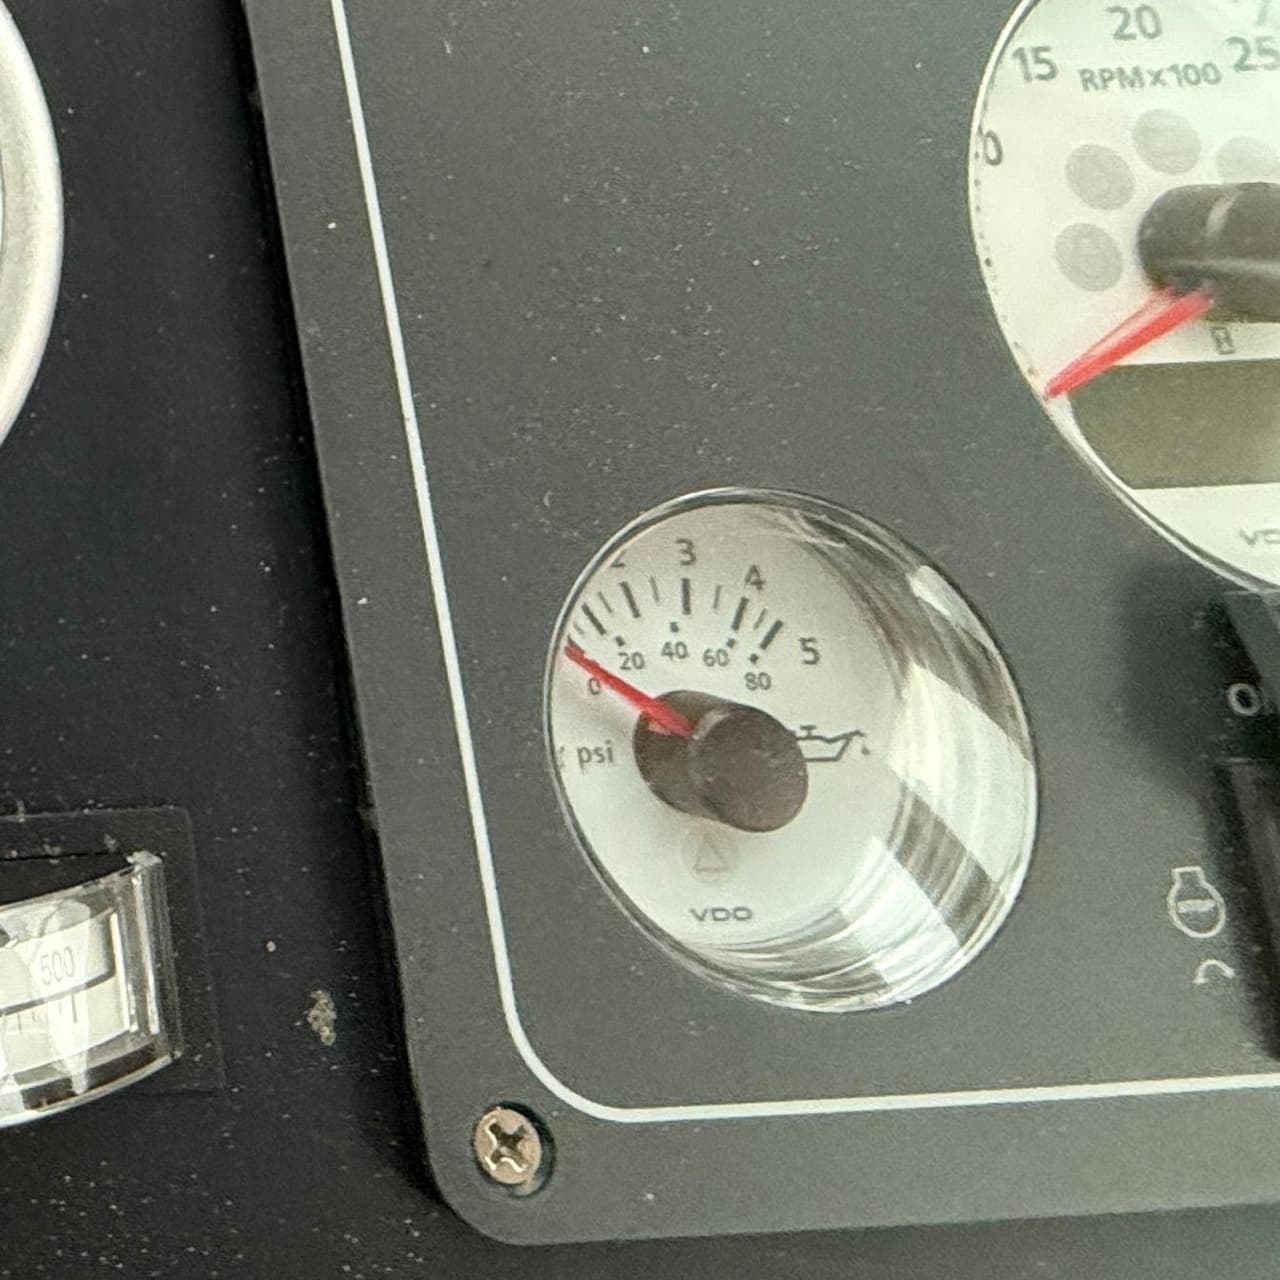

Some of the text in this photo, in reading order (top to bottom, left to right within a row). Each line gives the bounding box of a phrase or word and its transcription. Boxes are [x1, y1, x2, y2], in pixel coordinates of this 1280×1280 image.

[1105, 3, 1163, 41] 20
[1012, 45, 1058, 83] 15
[1225, 34, 1280, 73] 25
[676, 538, 697, 567] 3
[744, 563, 766, 591] 4
[618, 651, 645, 671] 20
[661, 640, 690, 660] 40
[702, 648, 731, 668] 60
[799, 636, 821, 666] 5
[744, 671, 773, 691] 80
[577, 738, 615, 770] psi
[689, 906, 754, 923] VDO
[40, 945, 76, 986] 500
